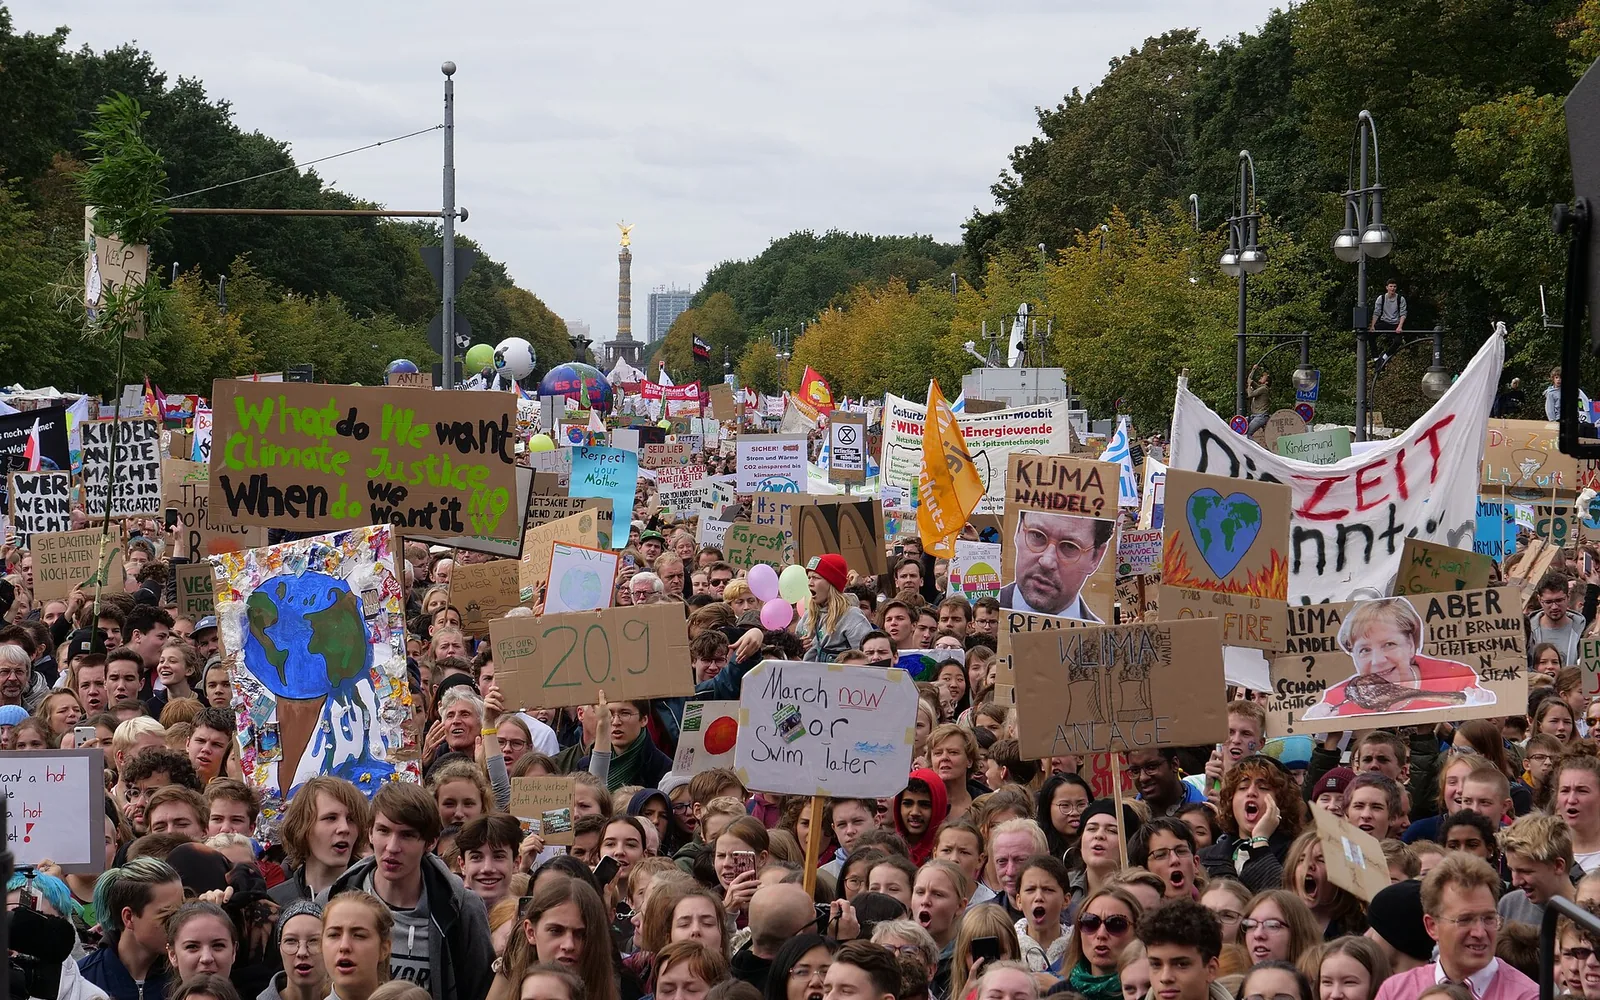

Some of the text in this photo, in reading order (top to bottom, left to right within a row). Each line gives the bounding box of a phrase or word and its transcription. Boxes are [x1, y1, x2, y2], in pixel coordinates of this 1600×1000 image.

[1299, 390, 1316, 399] TAXI
[3, 428, 23, 439] noch
[233, 394, 340, 441] What
[336, 407, 370, 441] do
[380, 403, 431, 448] We
[435, 412, 514, 465] want
[982, 437, 1050, 449] Spitzentechnologie
[1285, 435, 1333, 454] Kindermund
[1488, 429, 1514, 448] Die
[7, 443, 27, 455] Welt
[82, 443, 154, 465] AN DIE
[580, 447, 626, 466] Respect
[648, 445, 684, 455] SEID LIEB
[224, 431, 351, 477] Climate
[365, 447, 490, 491] Justice
[646, 456, 656, 466] ZU
[1290, 414, 1456, 523] ZEIT
[82, 463, 160, 485] MACHT
[594, 466, 618, 479] your
[657, 464, 707, 476] HEAL THE WORLD
[15, 474, 68, 496] WER
[137, 482, 159, 496] IN
[584, 473, 619, 488] Mother
[657, 476, 673, 485] MAKE
[673, 481, 692, 490] PLACE
[219, 473, 363, 524] When do
[367, 479, 408, 507] we
[659, 492, 670, 500] FOR
[16, 497, 70, 515] WENN
[572, 500, 587, 509] IST
[1014, 488, 1107, 517] WANDEL?
[439, 496, 464, 534] it
[553, 511, 565, 519] ZU
[757, 515, 776, 525] but
[15, 516, 71, 532] NICHT
[37, 538, 54, 552] SIE
[189, 531, 202, 564] B
[41, 552, 58, 565] SIE
[1412, 546, 1433, 568] We
[40, 566, 91, 582] NOCH ZEIT
[470, 567, 487, 578] IST
[965, 573, 997, 584] LOVE NATURE
[453, 578, 493, 593] EURER
[976, 582, 989, 591] HATE
[971, 590, 994, 600] FASCISM
[1212, 592, 1234, 606] GIRL
[1249, 598, 1261, 609] IS
[1425, 590, 1503, 624] ABER
[1223, 612, 1273, 643] FIRE
[1465, 618, 1522, 637] BRAUCH
[499, 638, 533, 651] IT'S OUR
[502, 647, 531, 659] FUTURE
[1058, 627, 1172, 669] KLIMA WANDEL
[1286, 636, 1340, 655] ANDEL
[541, 619, 649, 689] 20.9
[1480, 666, 1522, 683] STEAK
[761, 666, 887, 710] March now
[1268, 692, 1318, 713] WICHTIG
[808, 718, 849, 739] or
[1051, 716, 1172, 755] ANLAGE
[751, 724, 878, 776] Swim later
[28, 774, 37, 783] a
[46, 764, 66, 783] hot
[511, 793, 530, 807] statt
[23, 801, 43, 819] hot
